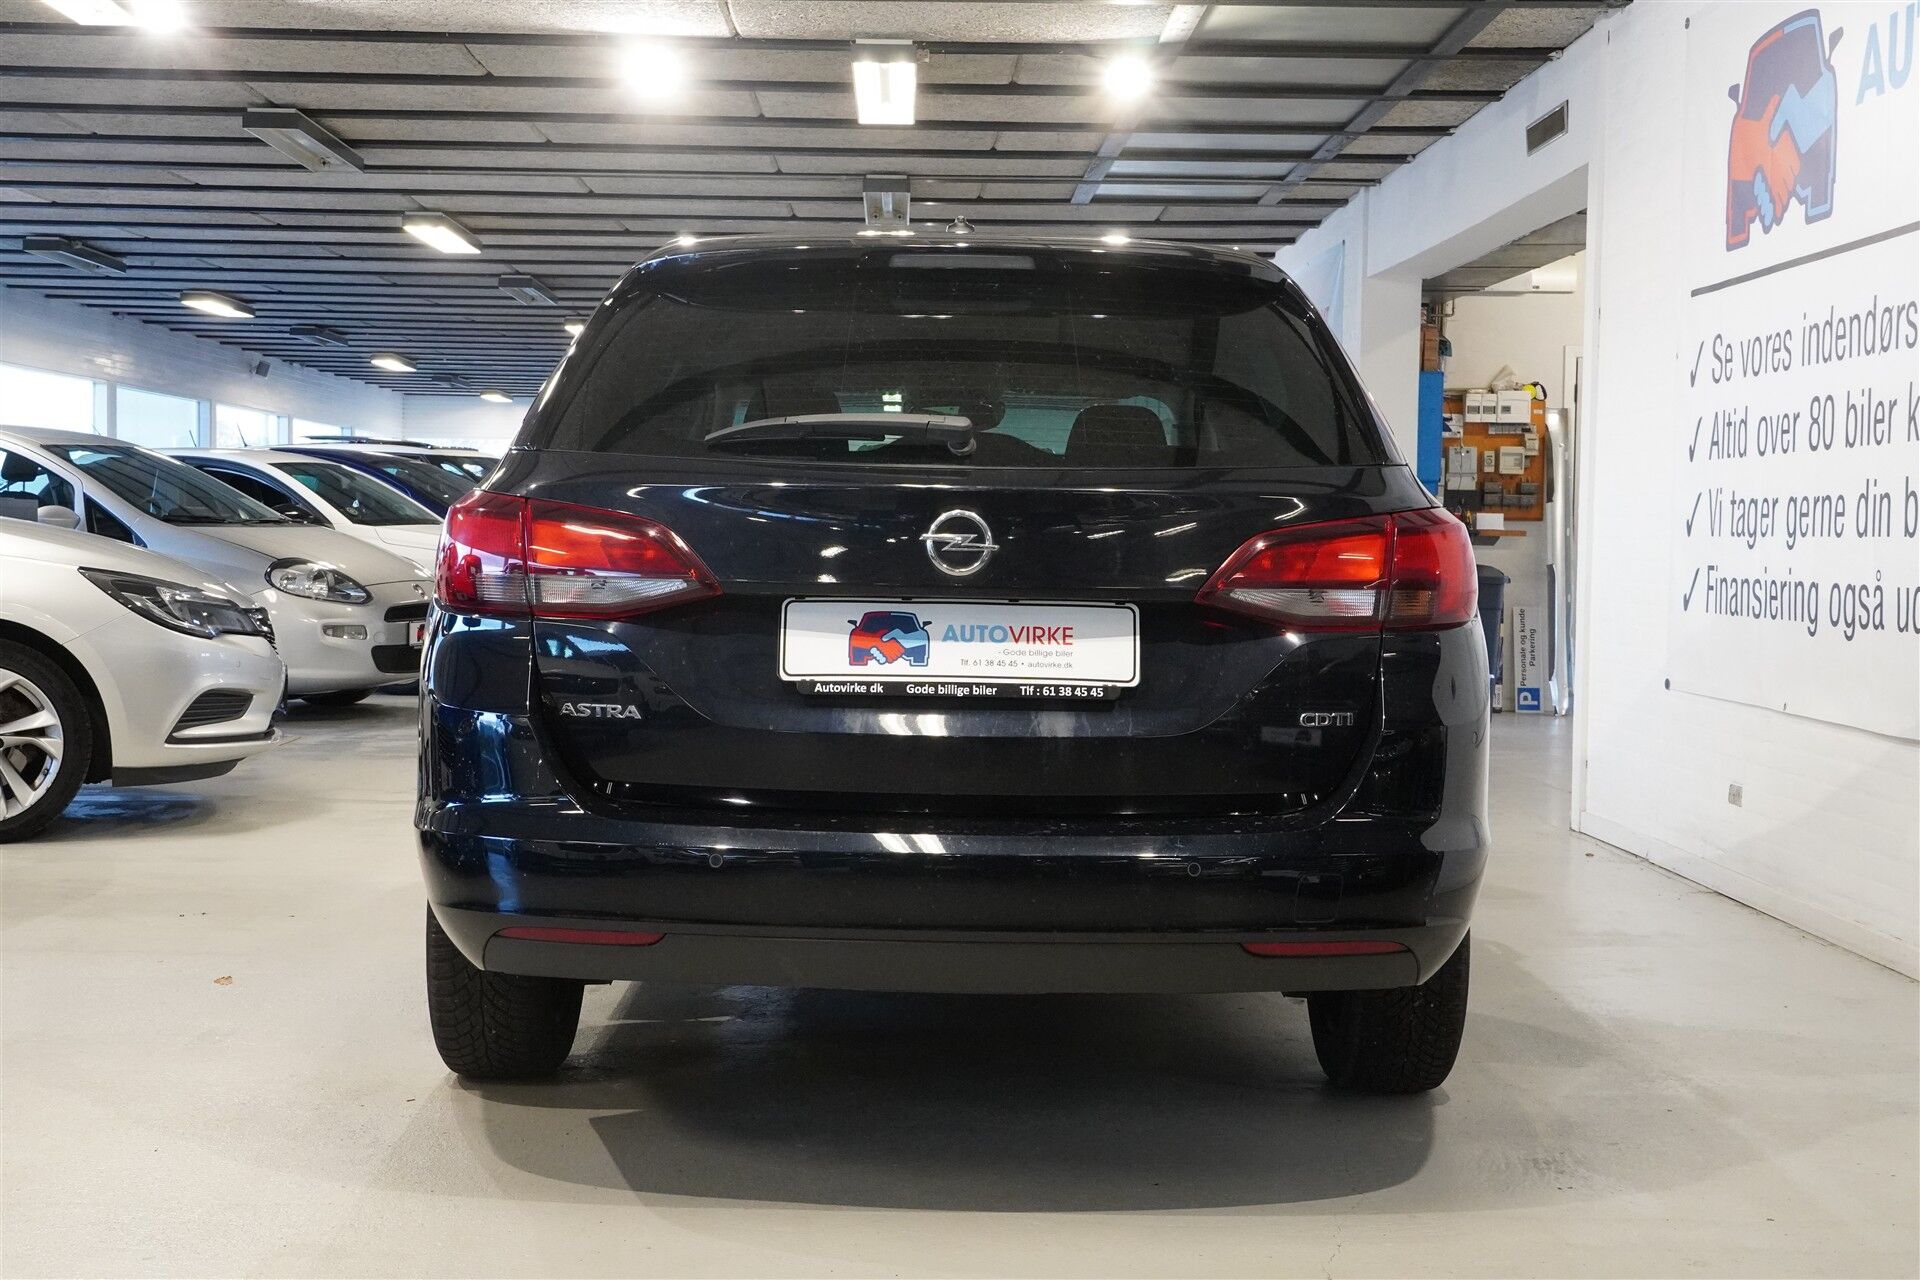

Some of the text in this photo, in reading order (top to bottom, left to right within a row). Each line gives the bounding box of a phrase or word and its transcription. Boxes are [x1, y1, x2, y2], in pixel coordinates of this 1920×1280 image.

[1856, 0, 1920, 106] AU
[1712, 295, 1918, 384] Se vores indendørs
[1708, 406, 1748, 460] Altid
[1757, 411, 1800, 457] over
[1808, 394, 1835, 451] 80
[1845, 387, 1898, 449] biler
[1708, 487, 1722, 537] Vi
[1730, 490, 1779, 550] tager
[1786, 494, 1846, 550] gerne
[1856, 478, 1891, 539] din
[1705, 565, 1819, 637] Finansiering
[1829, 569, 1885, 642] også
[1518, 608, 1526, 633] kunde
[941, 624, 1073, 646] AUTOVIRKE
[1520, 634, 1527, 645] og
[1028, 648, 1053, 658] billige
[1055, 649, 1073, 657] biler
[1528, 628, 1536, 667] Parkering
[972, 659, 982, 667] 61
[985, 659, 994, 667] 38
[1027, 660, 1073, 669] autovirke.dk
[814, 682, 867, 693] Autovirke
[870, 682, 884, 693] dk
[906, 683, 936, 694] Gode
[937, 684, 970, 697] billige
[972, 684, 997, 696] biler
[1042, 685, 1056, 696] 61
[1058, 686, 1072, 697] 38
[1074, 686, 1087, 697] 45
[1090, 687, 1104, 697] 45
[1519, 691, 1538, 706] P
[560, 702, 642, 719] ASTRA
